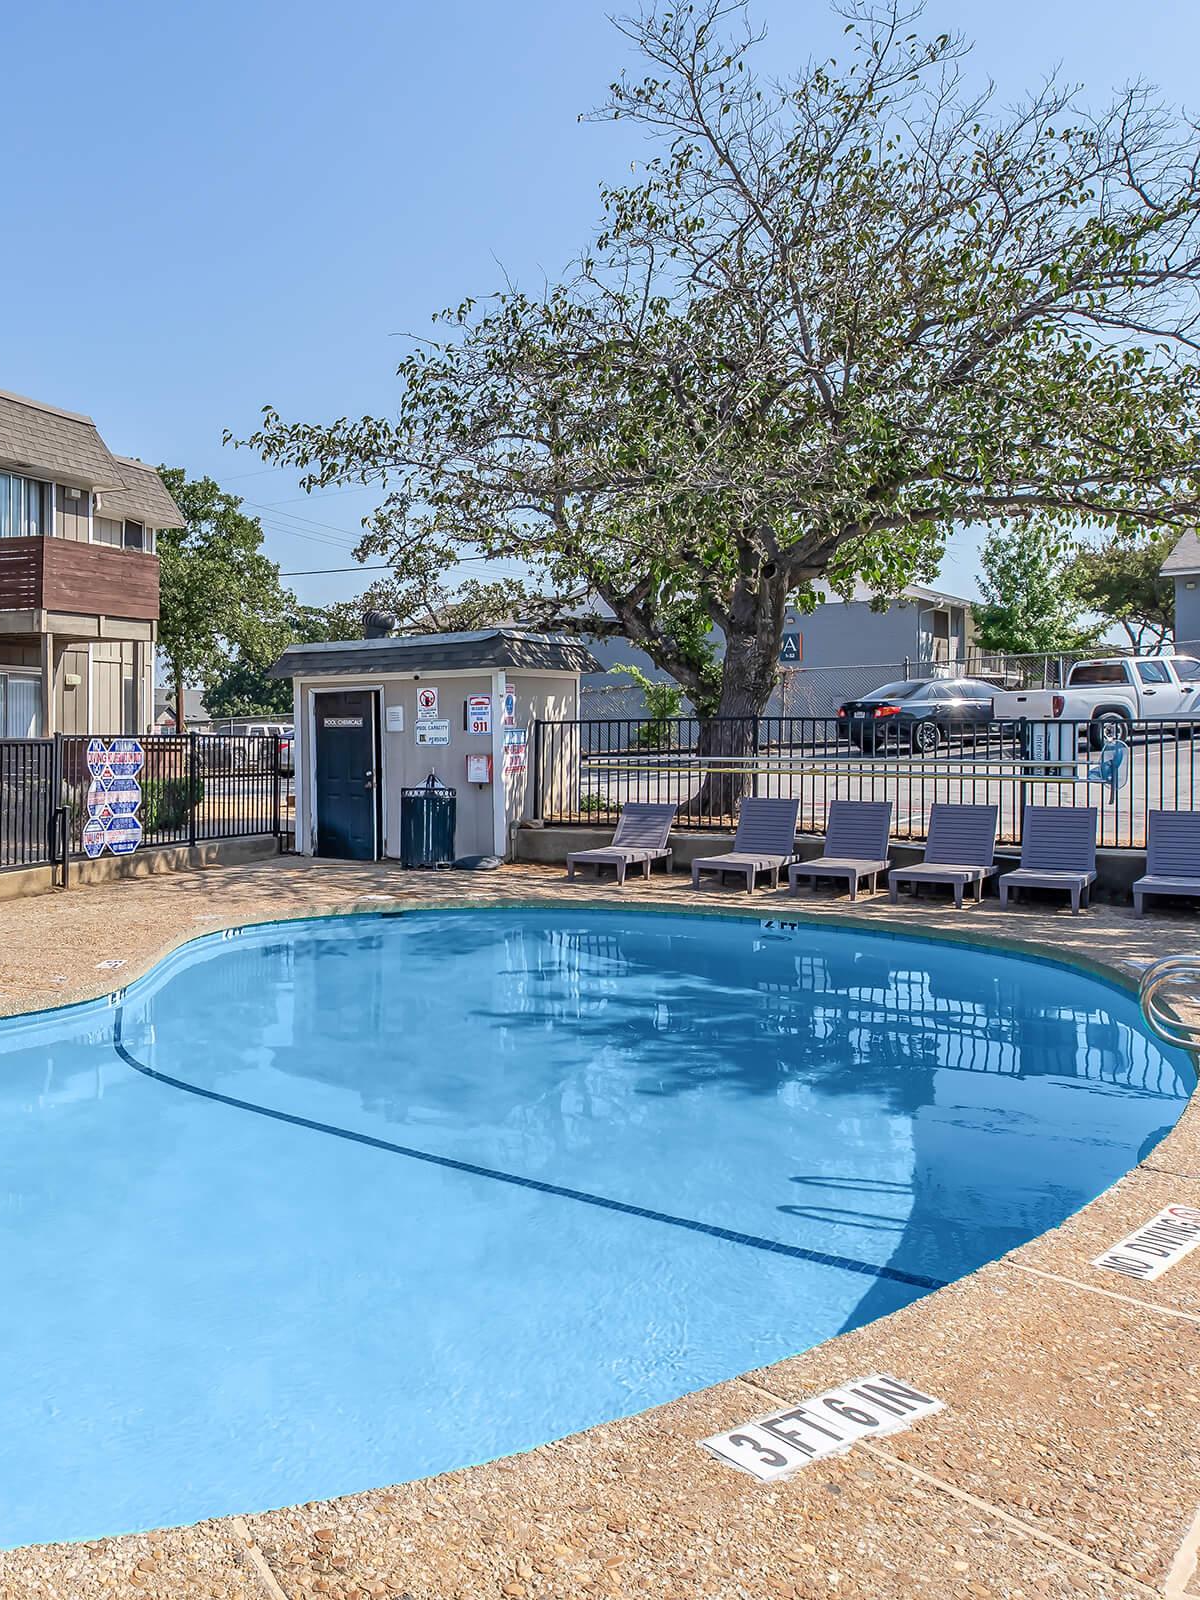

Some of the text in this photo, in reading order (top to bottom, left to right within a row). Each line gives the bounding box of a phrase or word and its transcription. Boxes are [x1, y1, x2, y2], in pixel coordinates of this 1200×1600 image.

[783, 636, 797, 652] A
[473, 721, 488, 732] 911
[88, 752, 107, 764] DIVING
[1098, 1219, 1200, 1277] NO DIVING
[728, 1376, 936, 1467] 3 FT 6 IN
